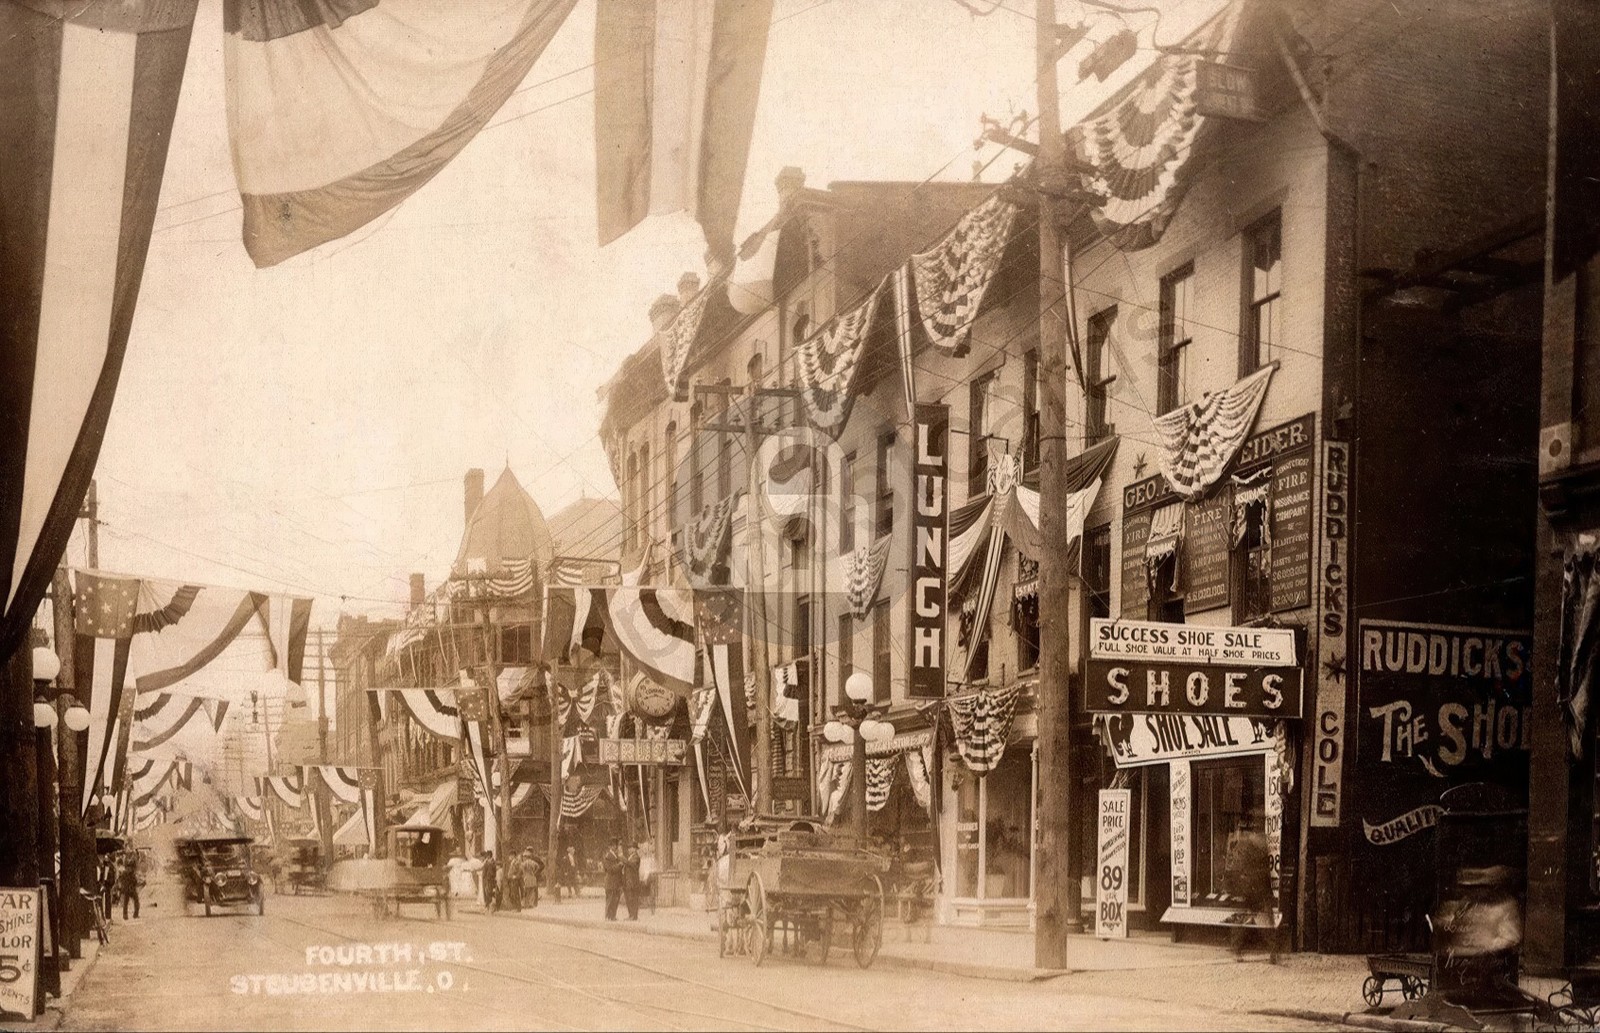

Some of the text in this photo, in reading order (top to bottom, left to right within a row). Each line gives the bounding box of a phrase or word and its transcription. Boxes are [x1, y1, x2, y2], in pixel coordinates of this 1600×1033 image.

[1278, 471, 1308, 491] FIRE
[1124, 481, 1159, 508] GEO.
[1193, 507, 1223, 527] FIRE
[1275, 504, 1308, 522] COMPANY
[914, 423, 943, 669] LUNCH
[1125, 528, 1148, 544] FIRE
[1322, 448, 1347, 638] RUDDICKS
[1099, 625, 1262, 649] SUCCESS SHOE SALE
[1098, 642, 1281, 661] FULL SHOE VALUE AT HALF SHOE PRICES
[1362, 629, 1524, 680] RUDDICKS
[1107, 667, 1284, 710] SHOES
[1146, 713, 1239, 755] SHOE SALE
[1316, 710, 1340, 817] COLE
[1102, 800, 1125, 814] SALE
[1102, 815, 1124, 828] PRICE
[1101, 865, 1123, 891] 89
[1100, 901, 1123, 922] BOX
[0, 913, 33, 934] SHINE
